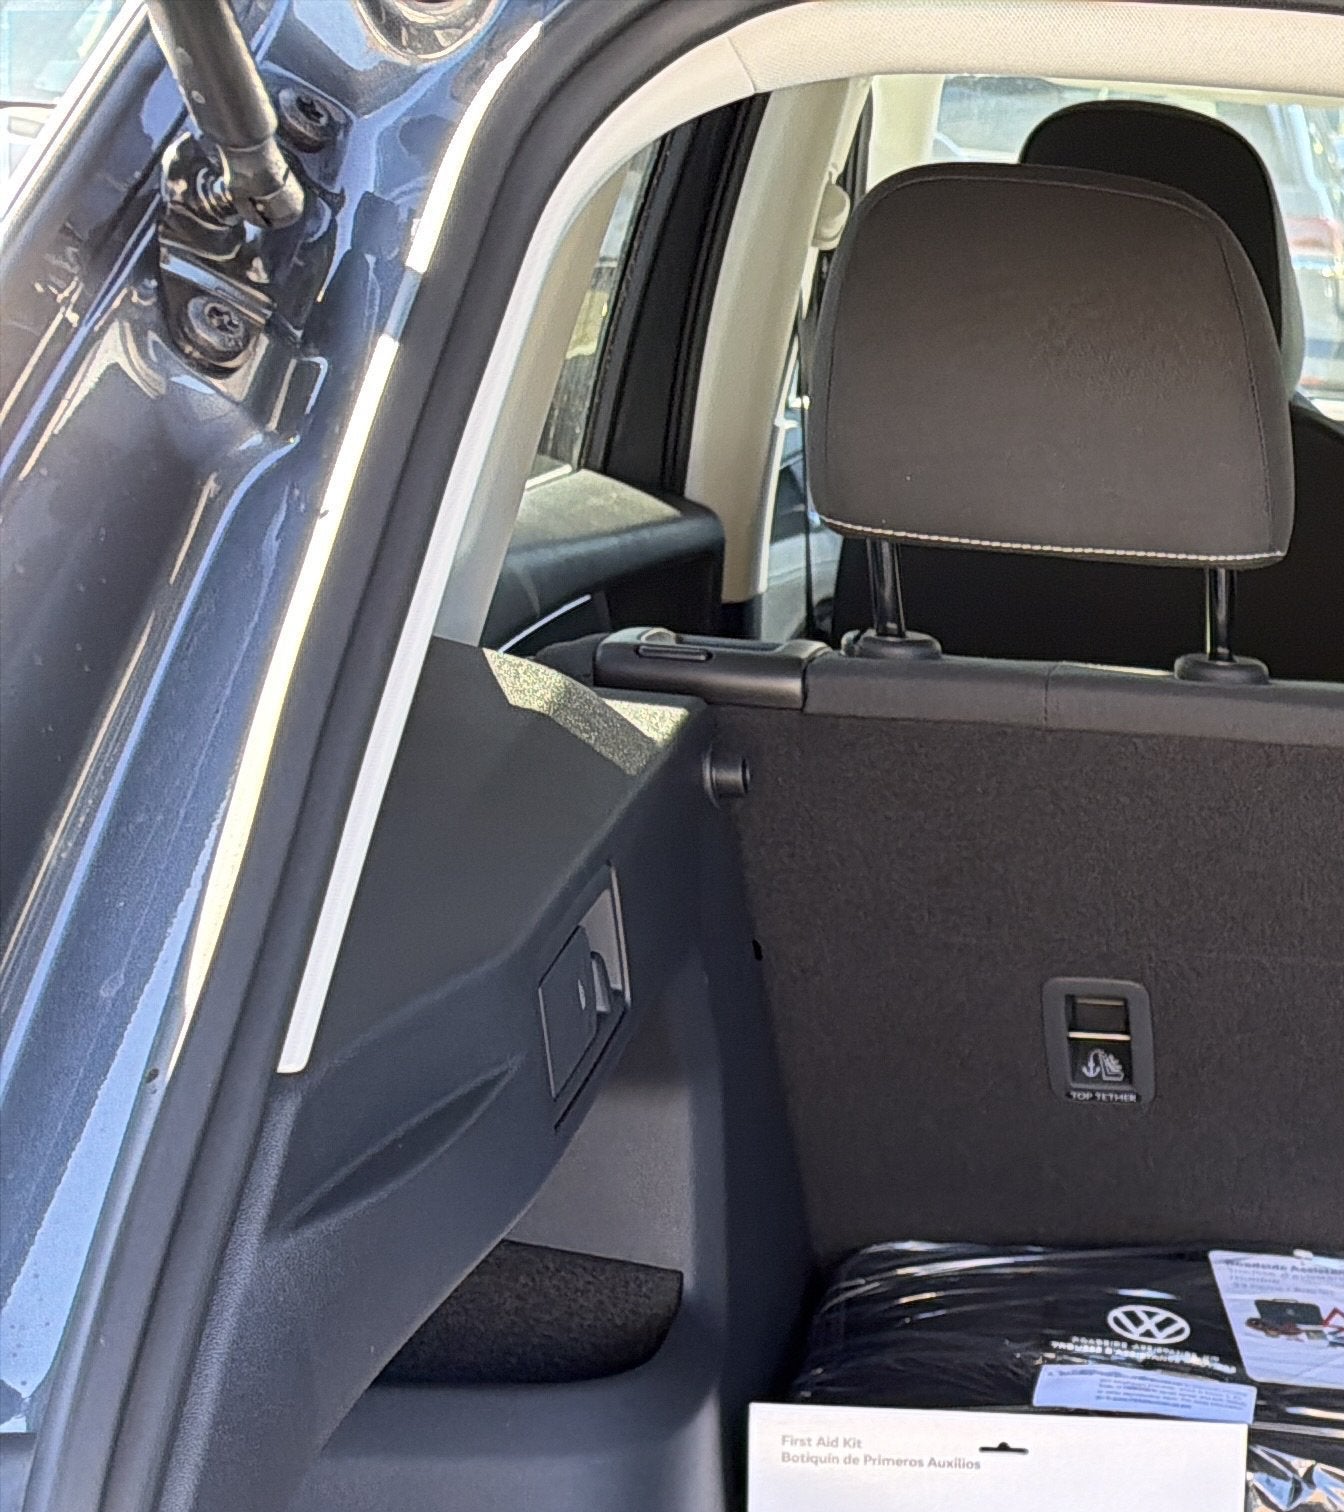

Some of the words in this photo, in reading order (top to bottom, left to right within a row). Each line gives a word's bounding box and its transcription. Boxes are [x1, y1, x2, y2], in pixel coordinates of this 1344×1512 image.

[1070, 1091, 1093, 1101] TOP
[781, 1435, 812, 1448] First
[816, 1436, 839, 1448] Aid
[843, 1437, 863, 1449] Kit
[843, 1454, 860, 1466] de
[863, 1455, 925, 1469] Primeros
[927, 1457, 981, 1470] Auxilios
